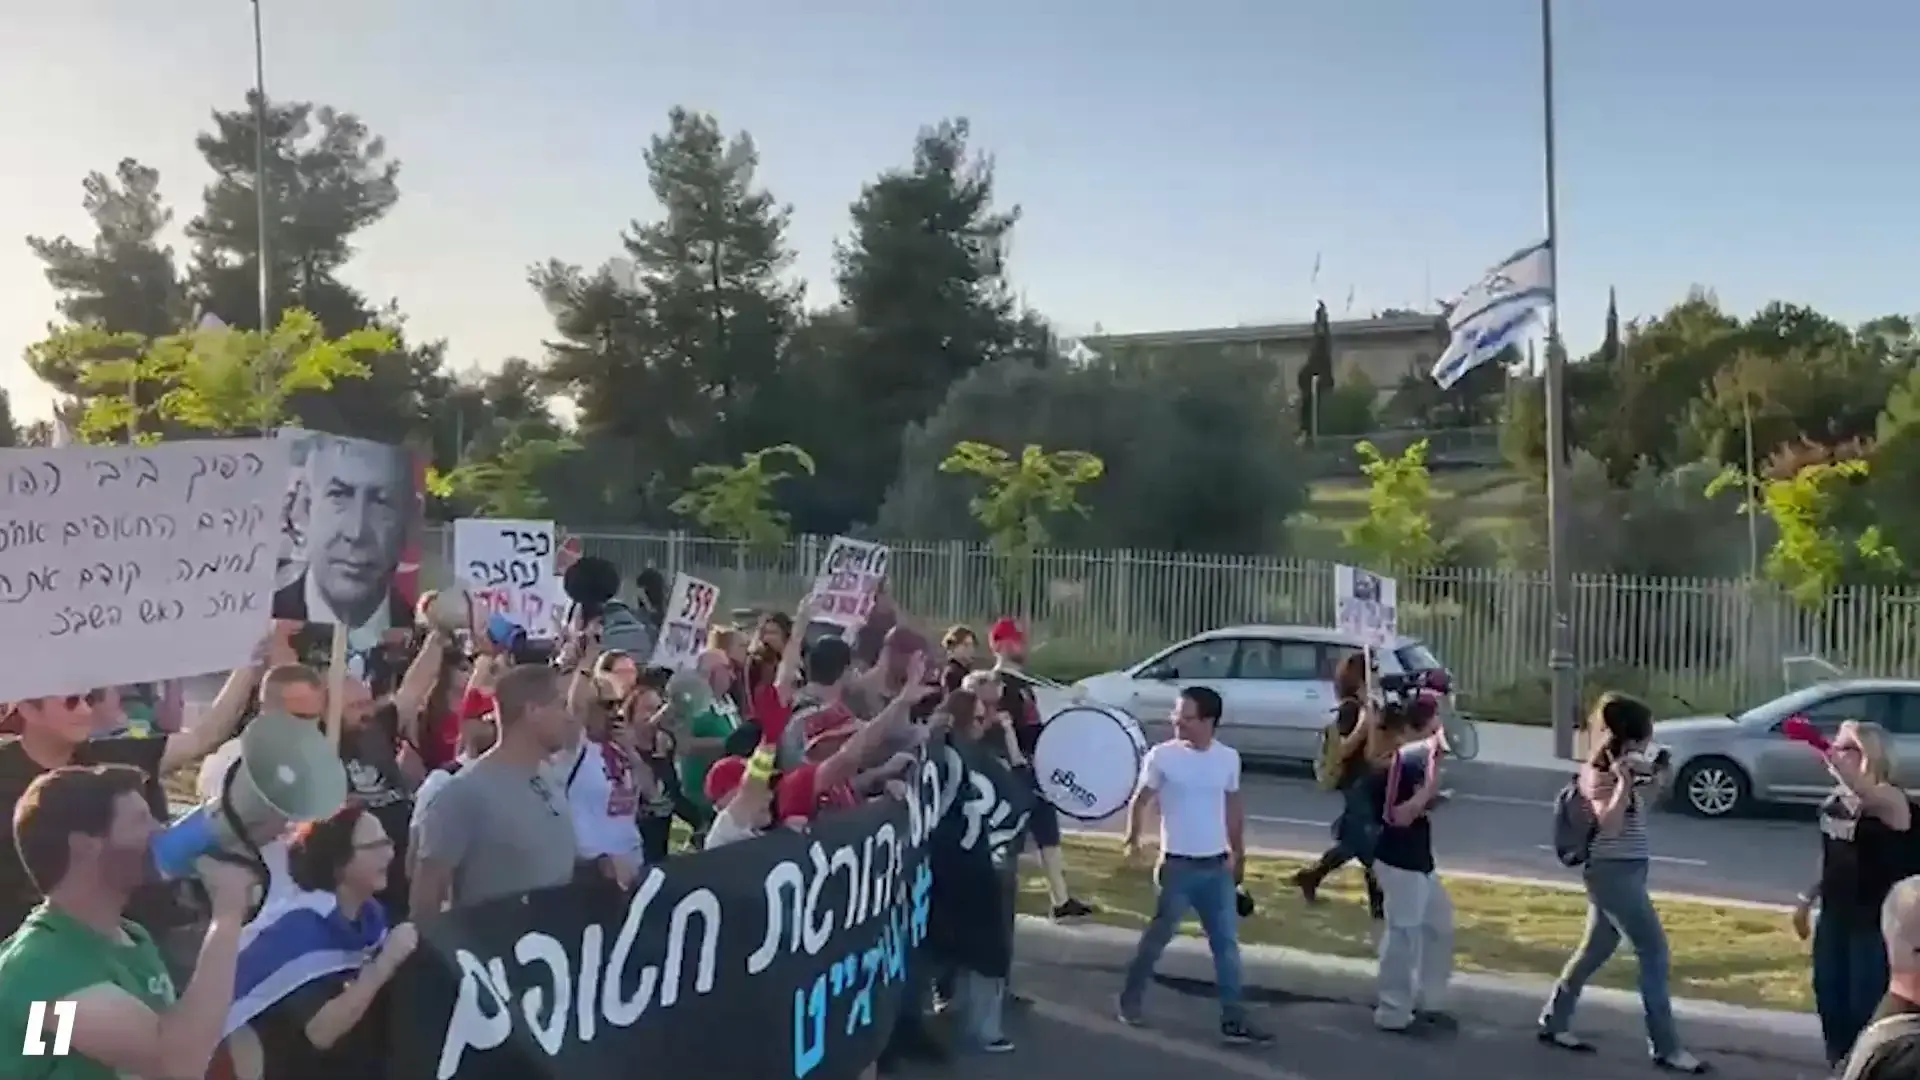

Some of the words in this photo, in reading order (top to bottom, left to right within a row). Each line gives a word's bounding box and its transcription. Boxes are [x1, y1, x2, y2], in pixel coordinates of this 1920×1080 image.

[7, 460, 62, 497] הפו
[85, 456, 159, 489] ביבי
[62, 513, 177, 547] החטופים
[197, 503, 265, 538] קודם
[500, 528, 551, 557] כבר
[6, 564, 61, 605] את
[78, 559, 143, 597] קודם
[468, 558, 540, 590] נחצה
[139, 598, 185, 626] ראש
[436, 866, 722, 1080] חטופים
